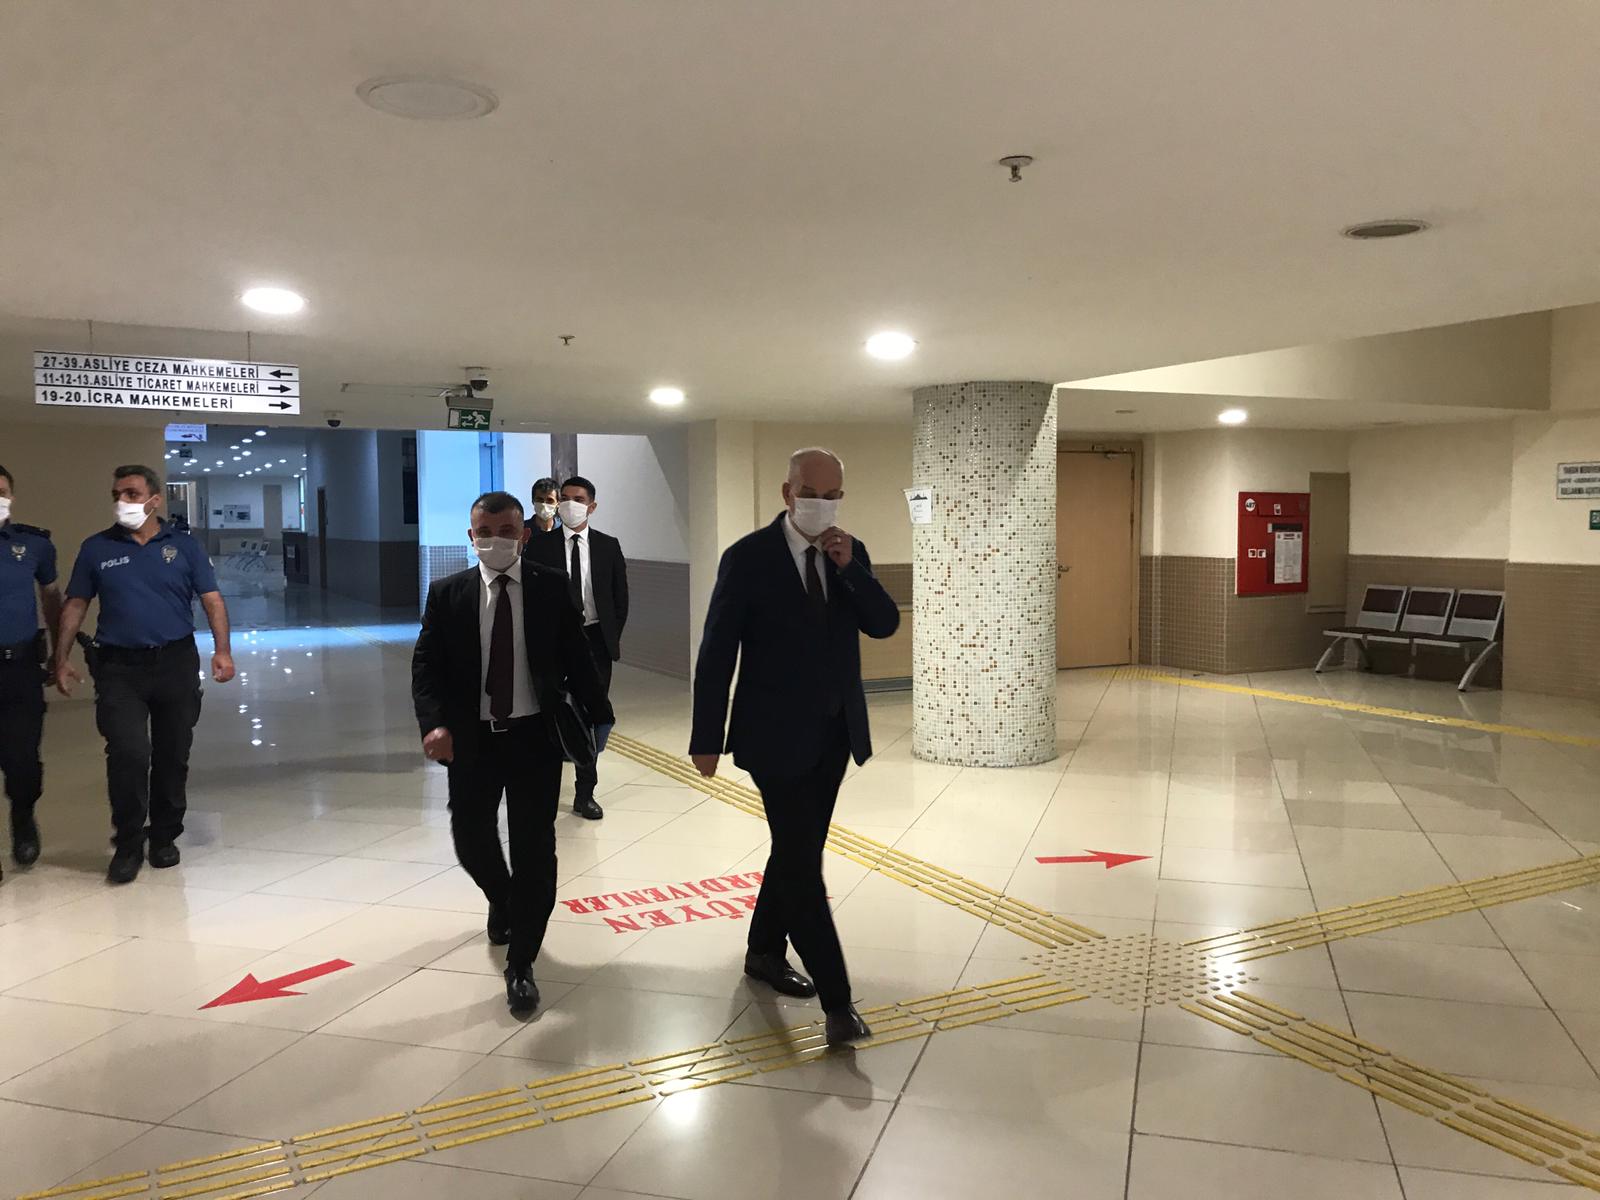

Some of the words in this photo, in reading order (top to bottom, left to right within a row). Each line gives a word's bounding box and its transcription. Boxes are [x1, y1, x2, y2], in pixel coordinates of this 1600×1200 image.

[42, 356, 130, 371] 27-39.ASLİYE
[135, 361, 168, 373] CEZA
[173, 364, 259, 378] MAHKEMELERİ
[42, 373, 133, 388] 11-12-13.ASLİYE
[137, 375, 182, 390] TİCARET
[186, 380, 259, 394] MAHKEMELERİ
[41, 389, 124, 404] 19-20.İCRA
[130, 394, 233, 409] MAHKEMELERİ
[559, 870, 766, 914] ERDİVENLER
[602, 894, 757, 934] RÜYEN
